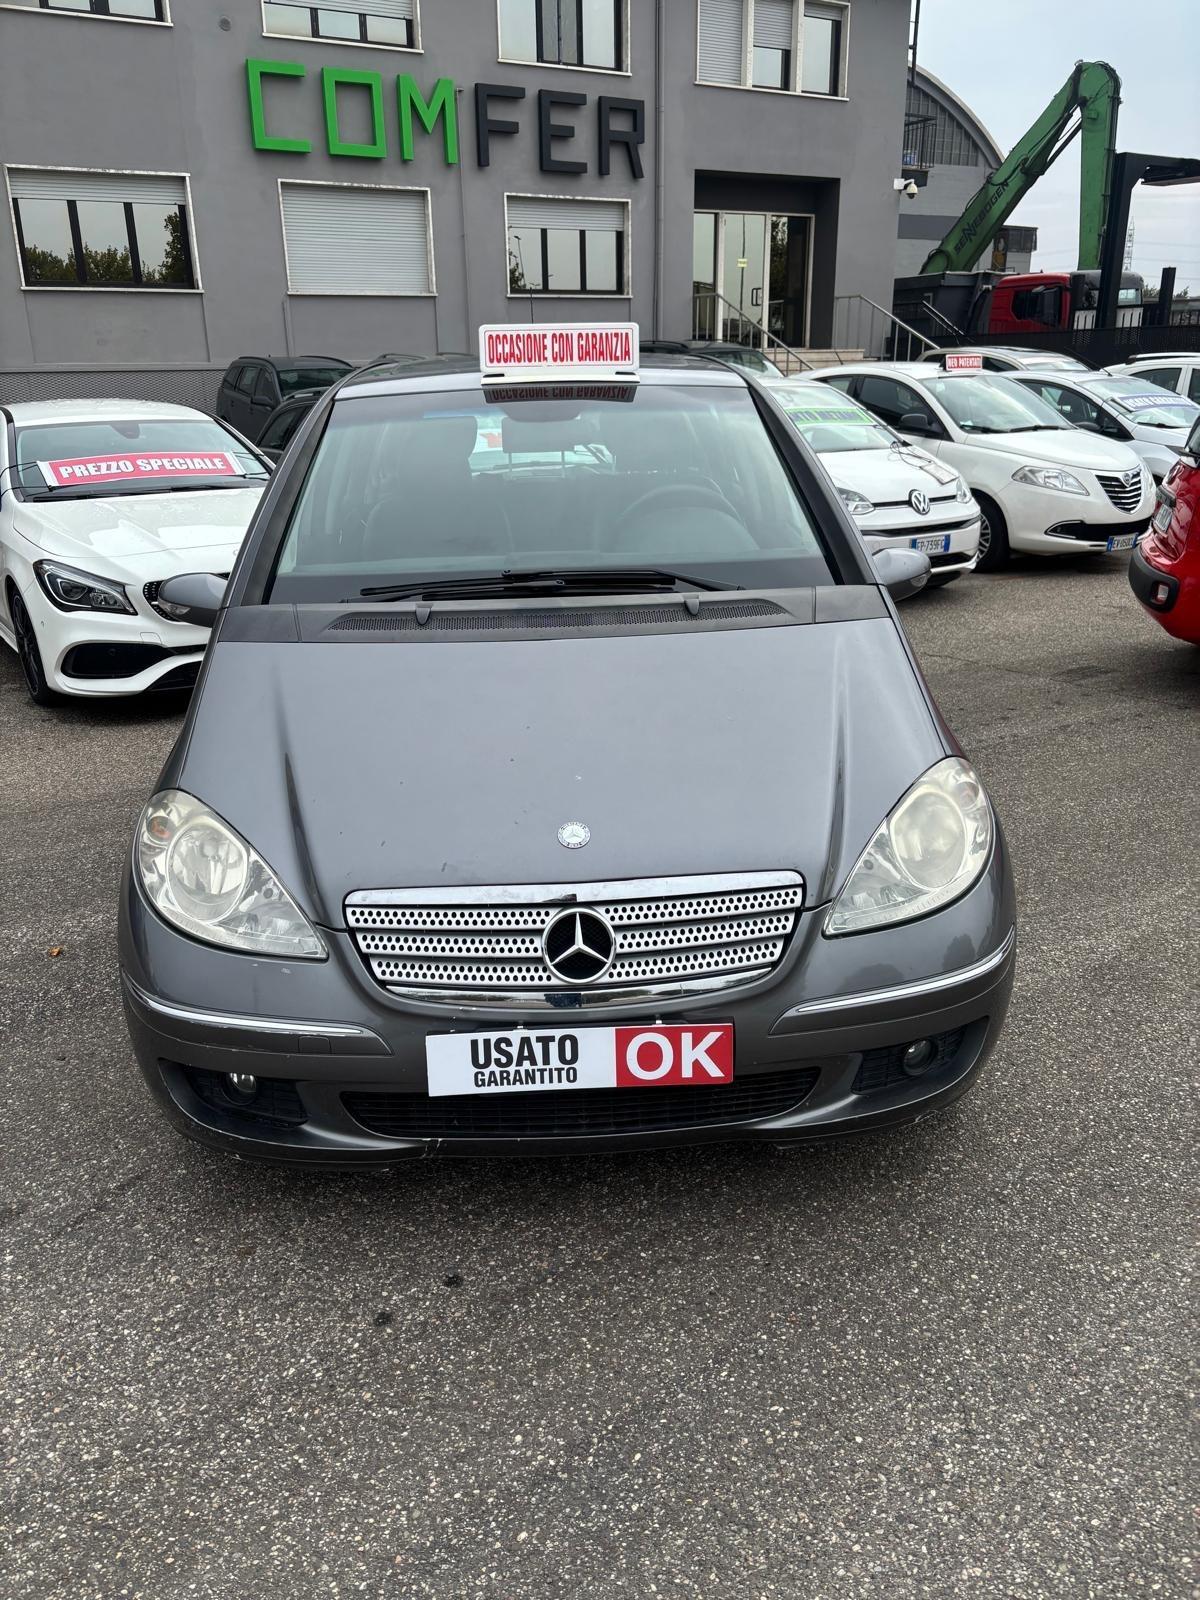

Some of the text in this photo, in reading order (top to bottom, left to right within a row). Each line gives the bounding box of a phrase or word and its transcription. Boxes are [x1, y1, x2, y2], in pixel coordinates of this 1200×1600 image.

[246, 58, 645, 179] COMFER
[487, 332, 631, 364] OCCASIONE CON GARANZIA
[58, 457, 227, 479] PREZZO SPECIALE
[470, 1034, 579, 1069] USATO
[626, 1031, 725, 1080] OK
[473, 1066, 578, 1088] GARANTITO
